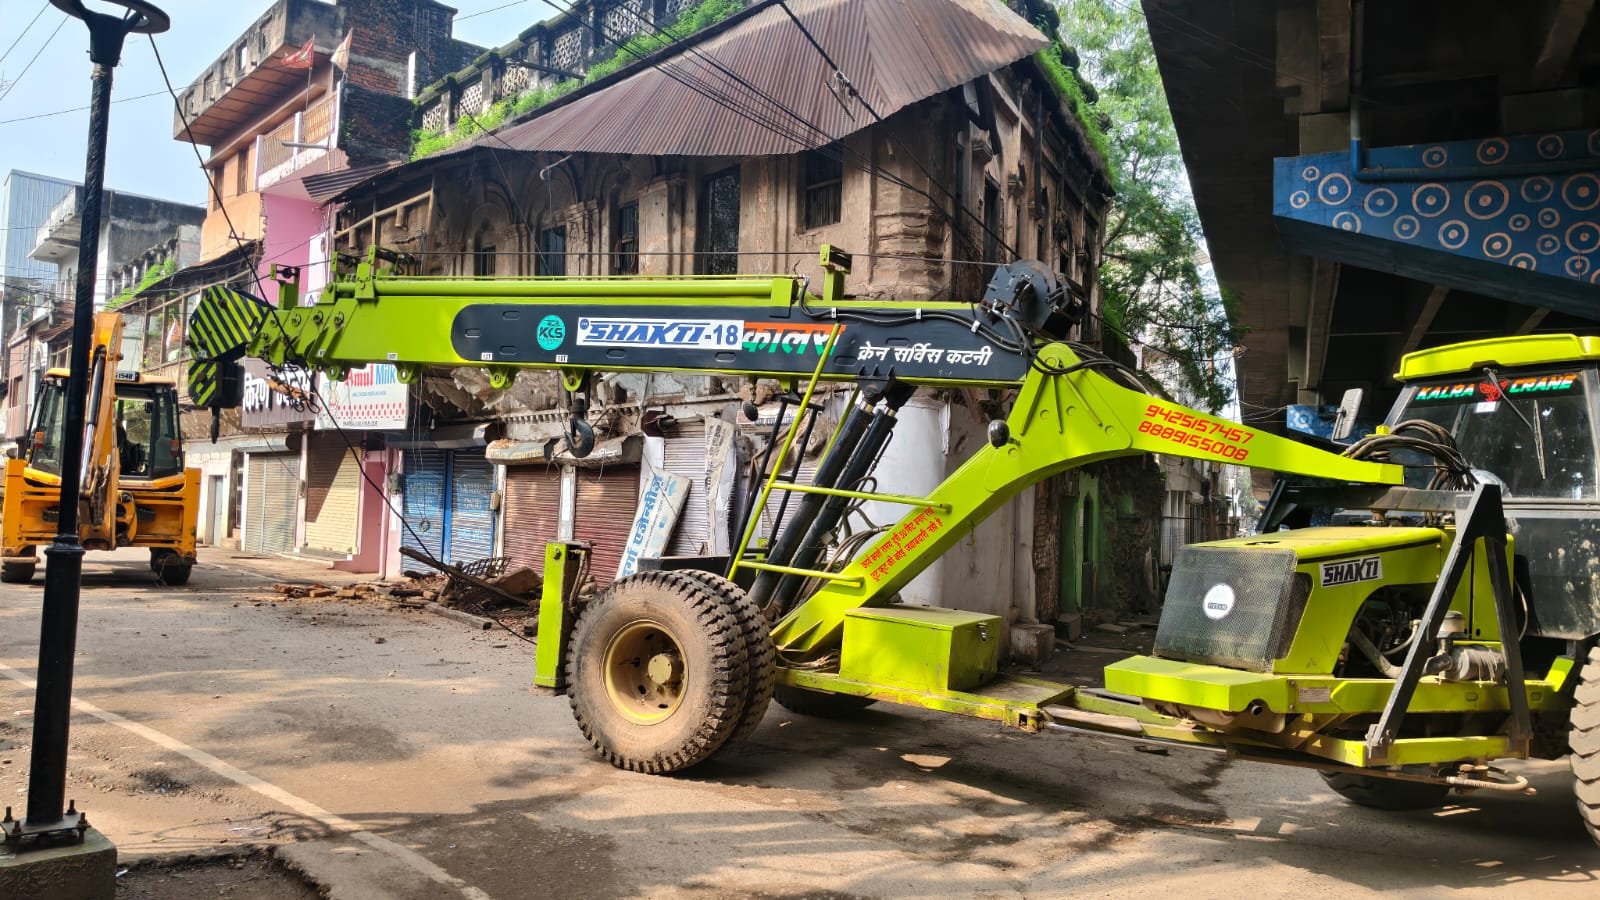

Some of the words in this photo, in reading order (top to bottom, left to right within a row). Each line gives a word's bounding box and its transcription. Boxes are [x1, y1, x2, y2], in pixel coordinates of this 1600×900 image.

[539, 326, 563, 339] KCS
[585, 322, 739, 346] SHAKTI-18
[857, 341, 889, 361] क्रेन
[894, 343, 944, 363] सर्विस
[946, 346, 993, 366] कटनी
[344, 363, 374, 388] Amul
[375, 363, 396, 385] Milk
[1416, 383, 1475, 400] KALRA
[1509, 374, 1578, 393] CRANE
[1144, 404, 1255, 444] 9425157457
[1138, 420, 1249, 461] 8889155008
[1322, 559, 1380, 584] SHAKTI
